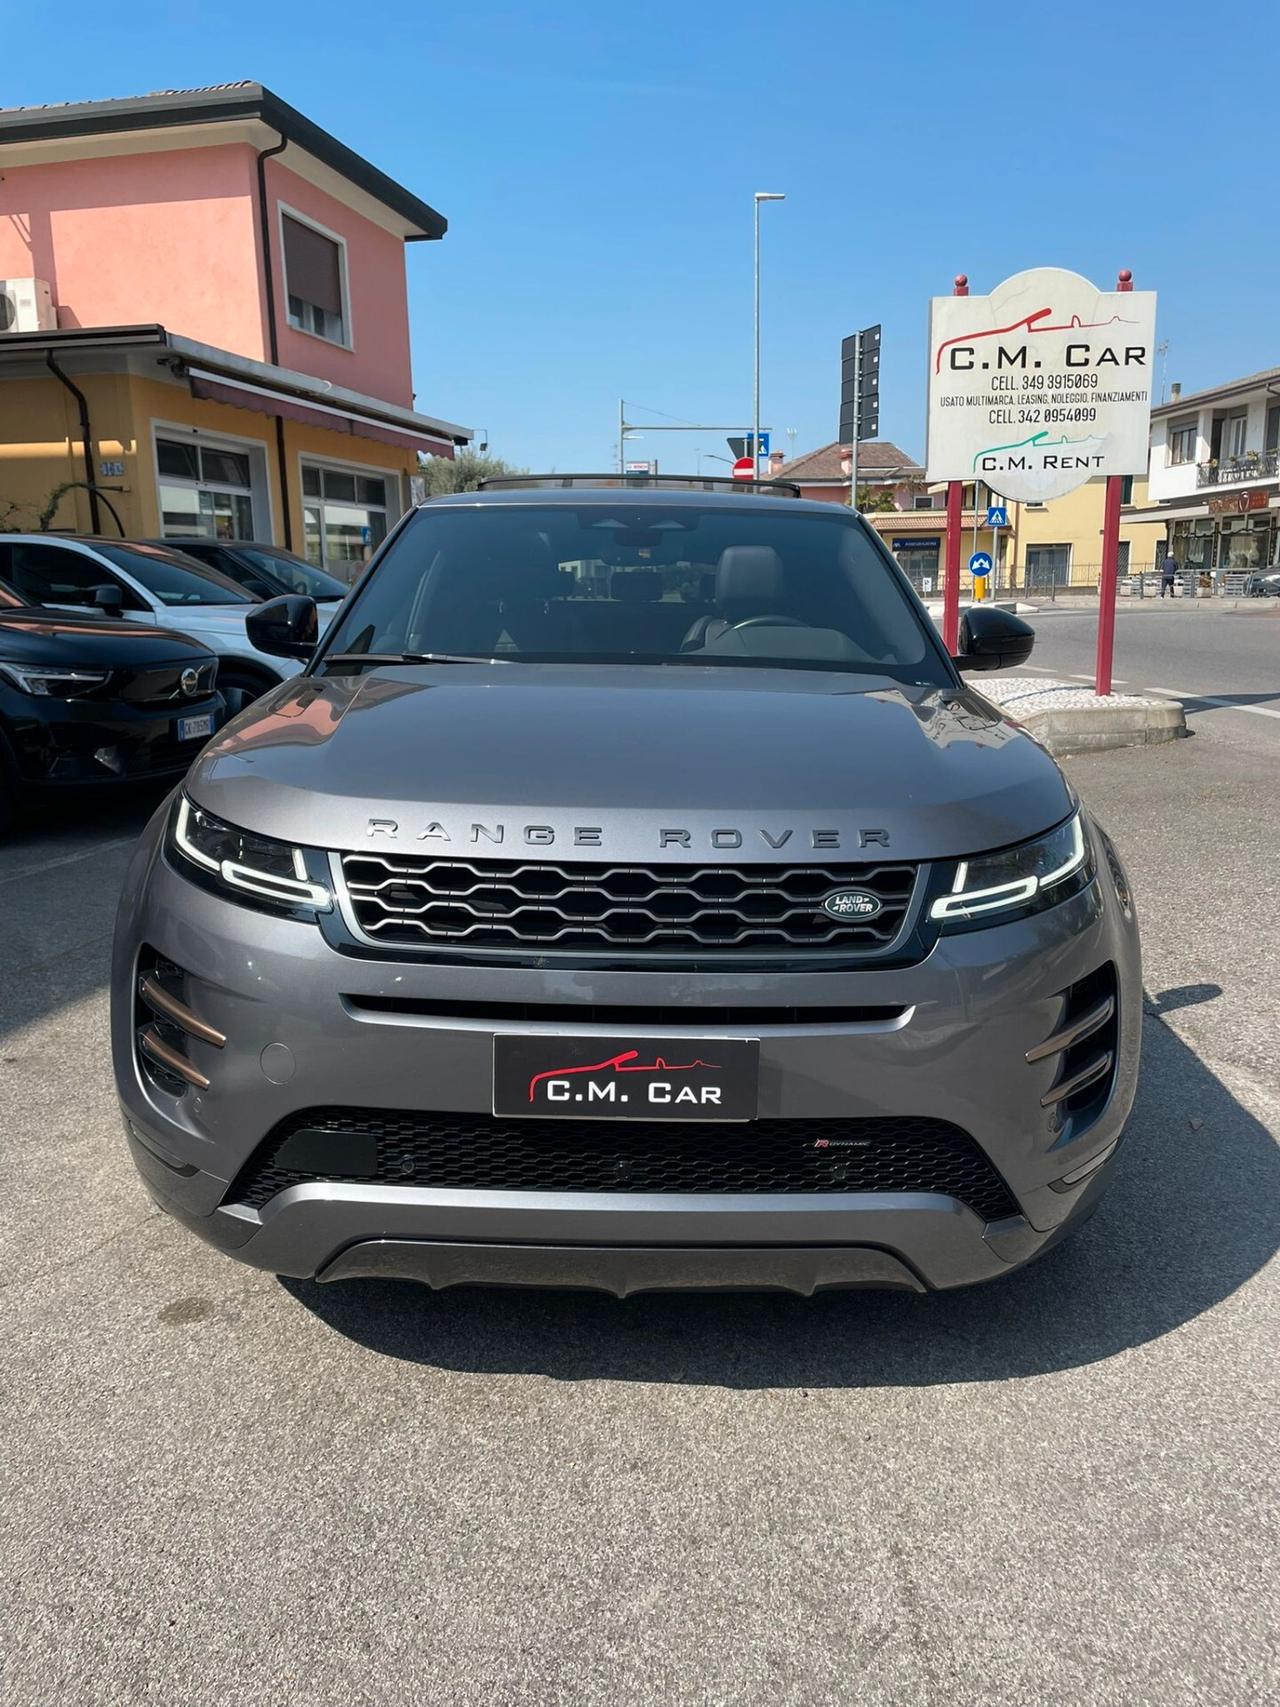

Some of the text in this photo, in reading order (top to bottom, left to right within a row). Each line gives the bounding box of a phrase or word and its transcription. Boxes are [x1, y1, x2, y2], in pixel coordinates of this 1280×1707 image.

[950, 346, 1042, 371] C.M.
[991, 373, 1098, 390] CELL. 349 3915069
[940, 396, 965, 407] USATO
[1091, 391, 1148, 403] FINANZIAMENTI
[989, 407, 1097, 424] CELL. 342 0954099
[982, 456, 1033, 471] C.M.
[367, 818, 890, 848] RANGE ROVER
[835, 895, 863, 905] LAND
[838, 903, 873, 913] ROVER
[547, 1080, 629, 1102] C.M.
